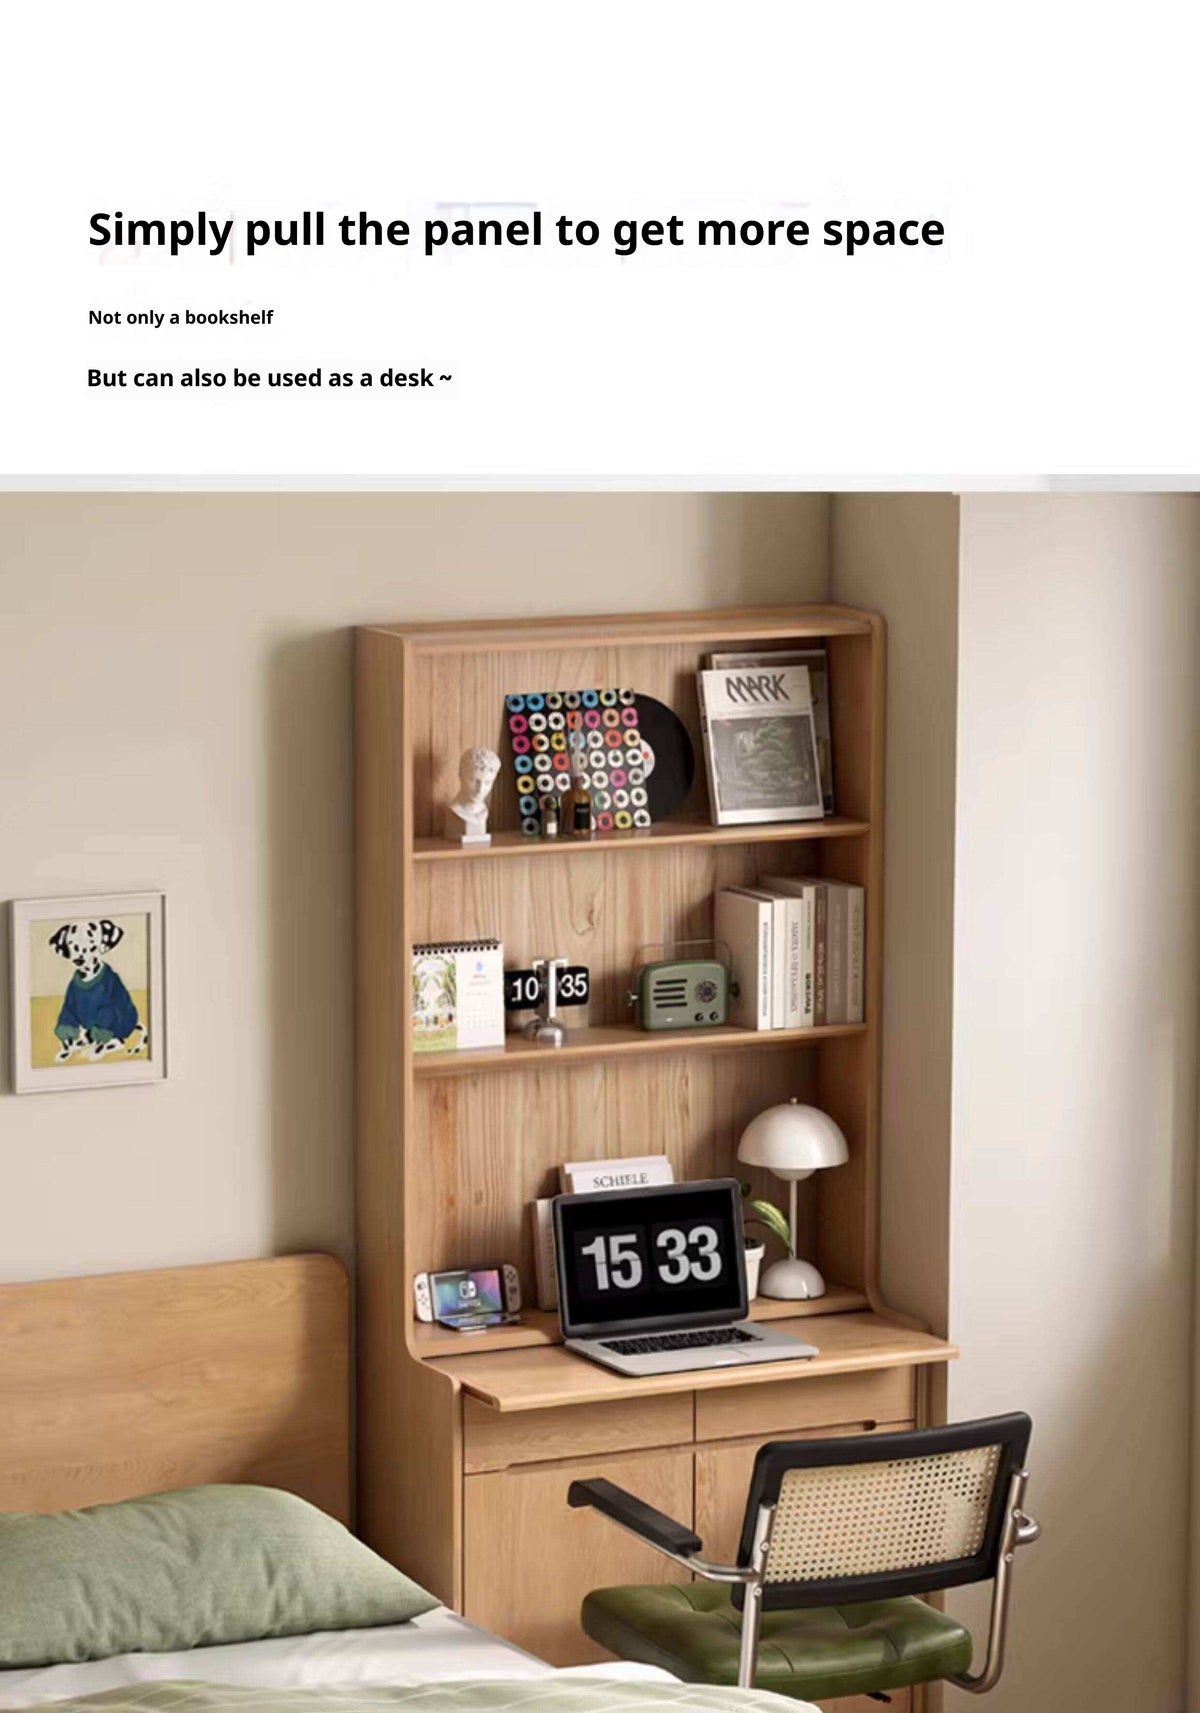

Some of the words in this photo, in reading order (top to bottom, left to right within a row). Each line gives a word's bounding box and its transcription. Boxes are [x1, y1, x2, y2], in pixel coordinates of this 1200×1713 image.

[725, 674, 790, 703] MARK
[511, 976, 539, 1002] 10
[560, 973, 588, 998] 35
[581, 1233, 643, 1291] 15
[655, 1225, 723, 1285] 33
